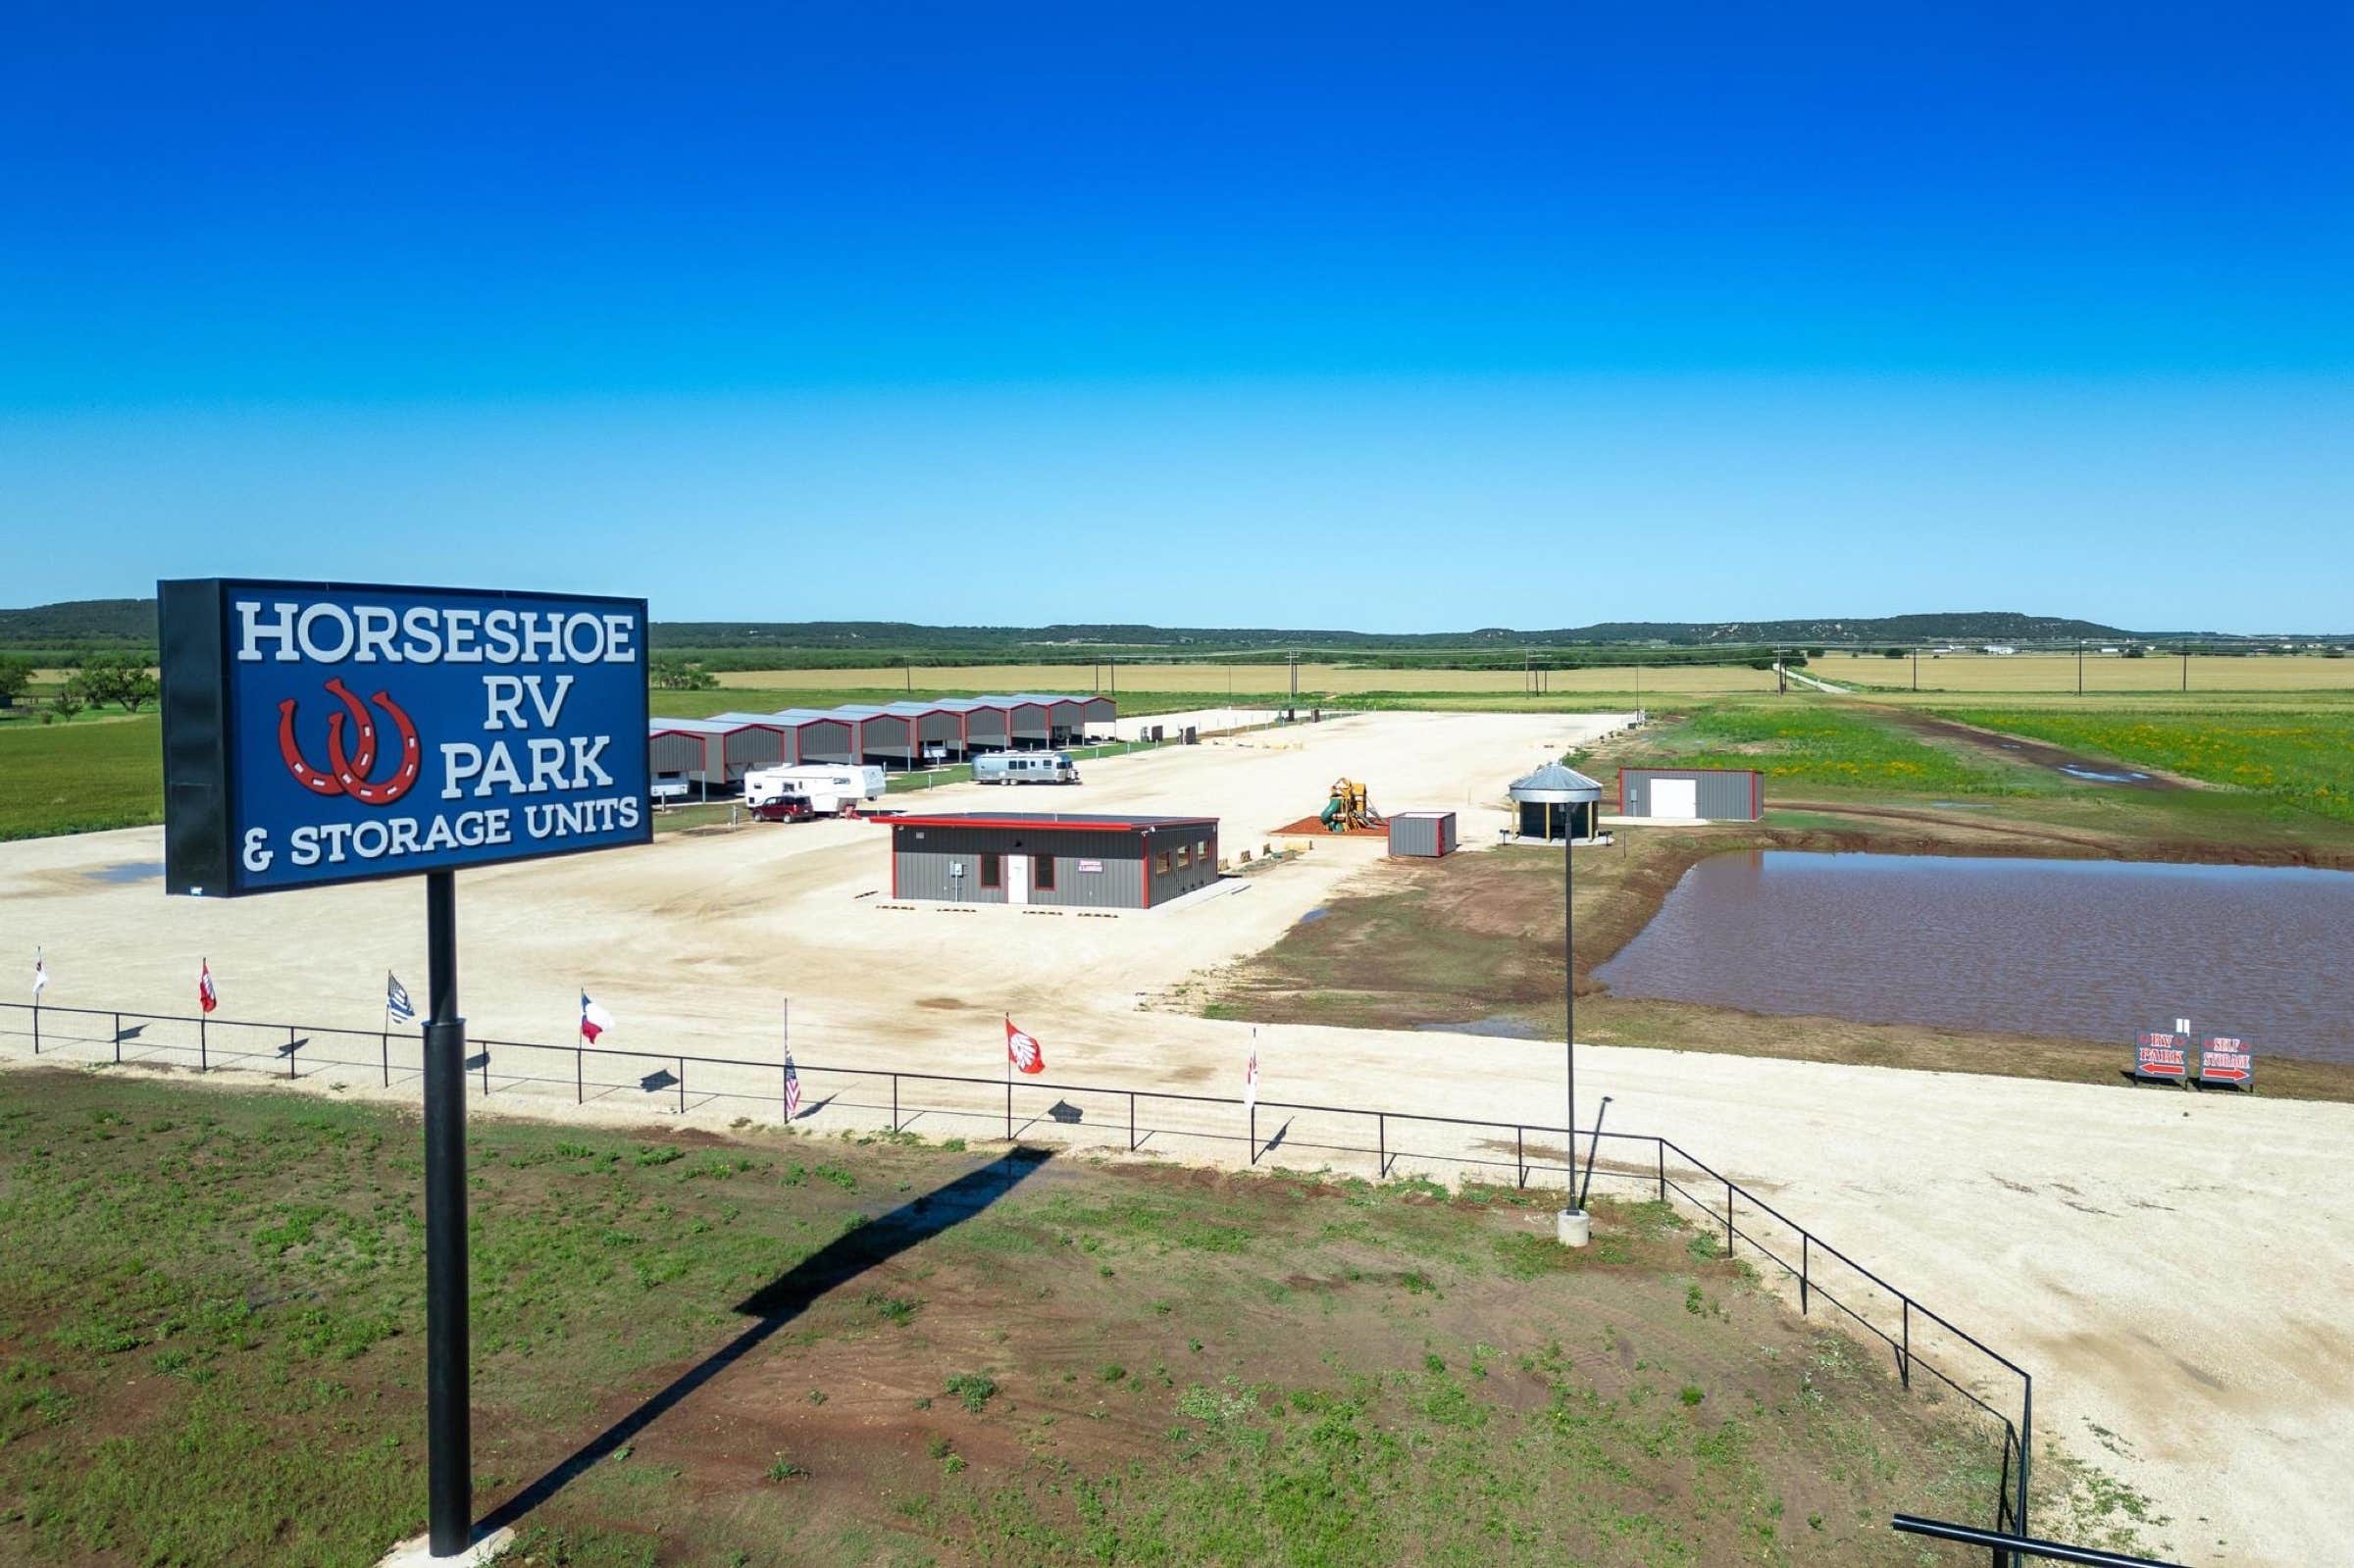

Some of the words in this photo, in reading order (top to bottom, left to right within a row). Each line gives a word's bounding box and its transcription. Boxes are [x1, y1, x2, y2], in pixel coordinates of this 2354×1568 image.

[235, 601, 636, 664] HORSESHOE
[483, 675, 574, 730] RV
[439, 735, 613, 799] PARK
[242, 828, 274, 872] &
[291, 808, 511, 865] STORAGE
[525, 796, 640, 838] UNITS
[2139, 1047, 2184, 1064] PARK
[2151, 1033, 2174, 1048] RV
